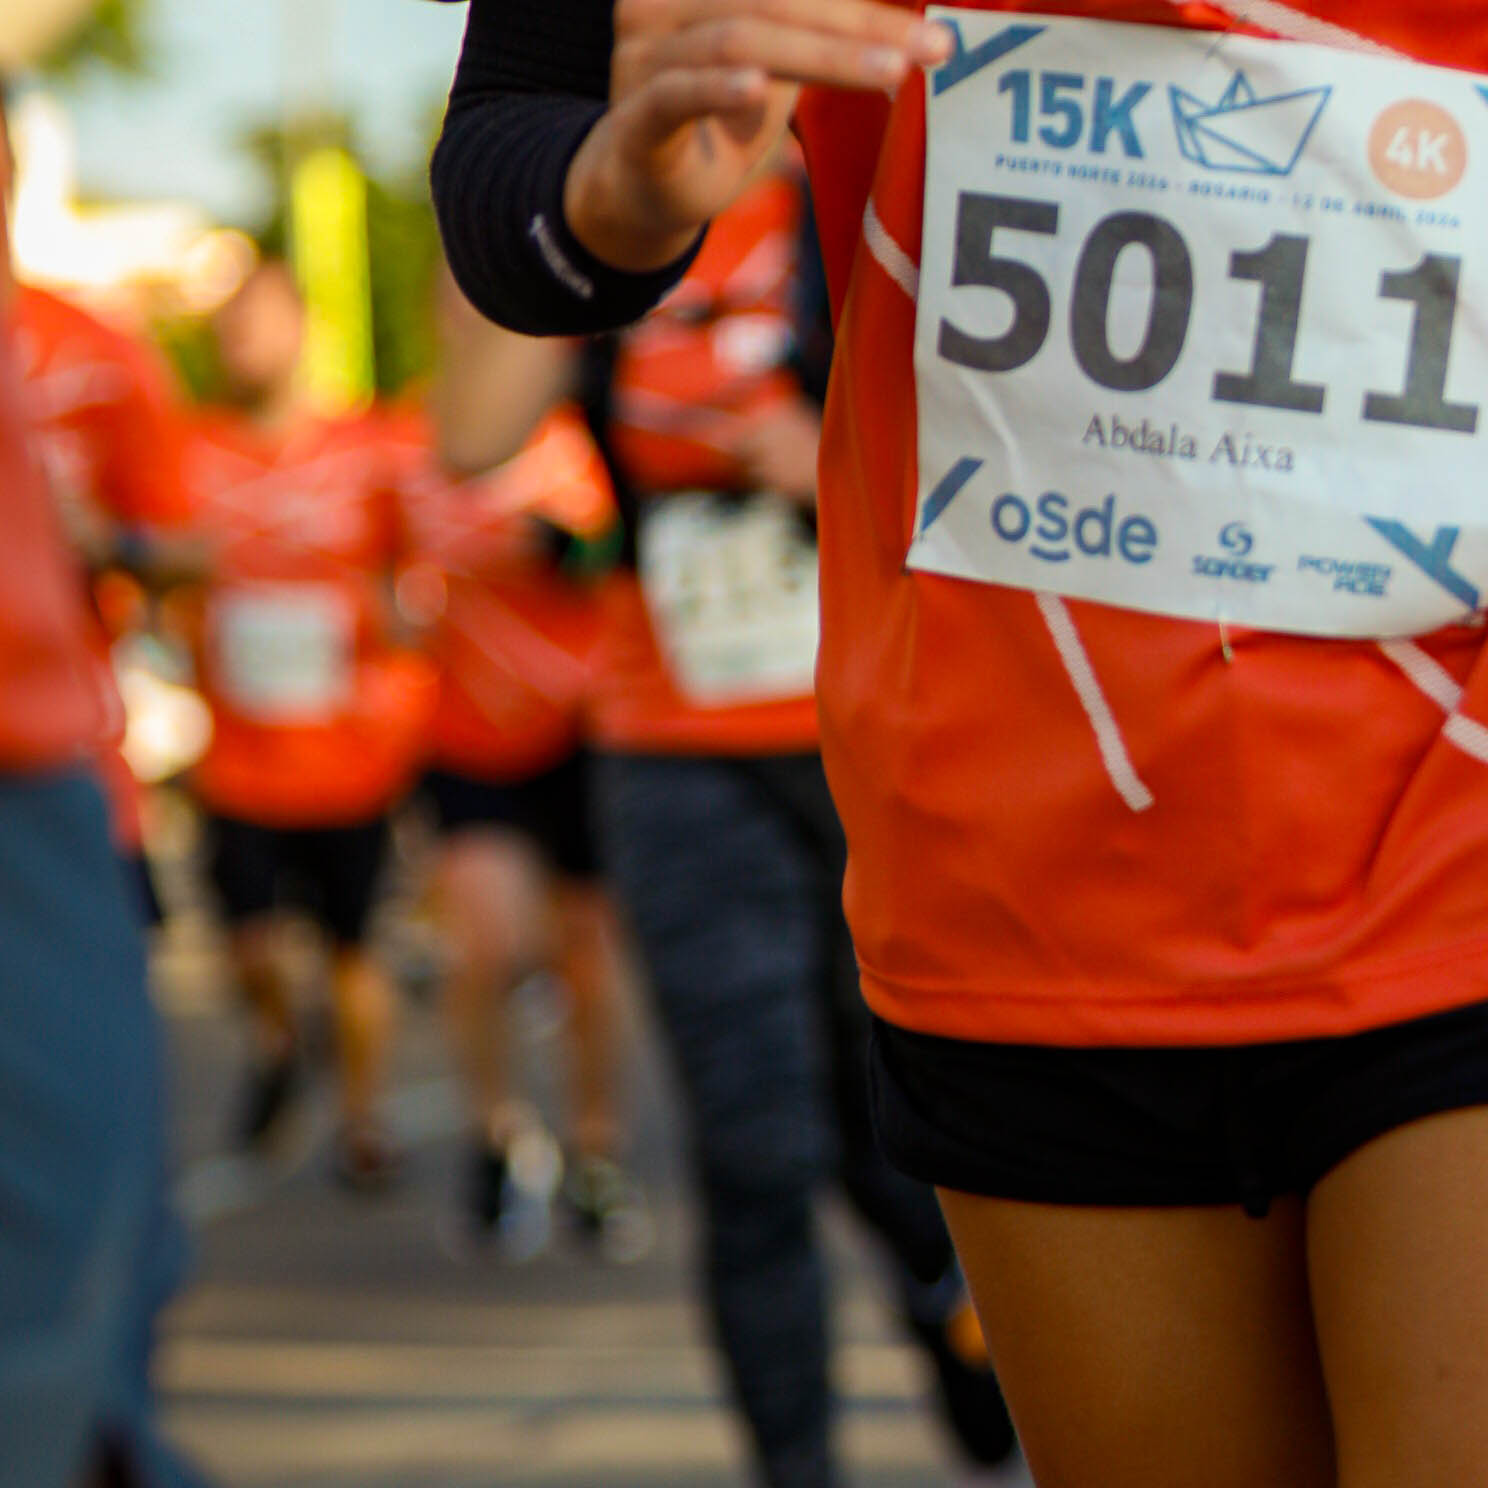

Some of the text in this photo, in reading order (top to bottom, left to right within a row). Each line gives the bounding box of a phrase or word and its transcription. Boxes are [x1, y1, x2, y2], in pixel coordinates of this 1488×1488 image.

[997, 68, 1153, 159] 15K
[995, 154, 1062, 178] PUERTO
[1066, 164, 1120, 185] NORTE
[1187, 178, 1270, 203] ROSARIO
[1384, 125, 1449, 176] 4K
[937, 190, 1479, 434] 5011
[1082, 413, 1296, 472] Abdala Aixa
[990, 491, 1157, 565] osde
